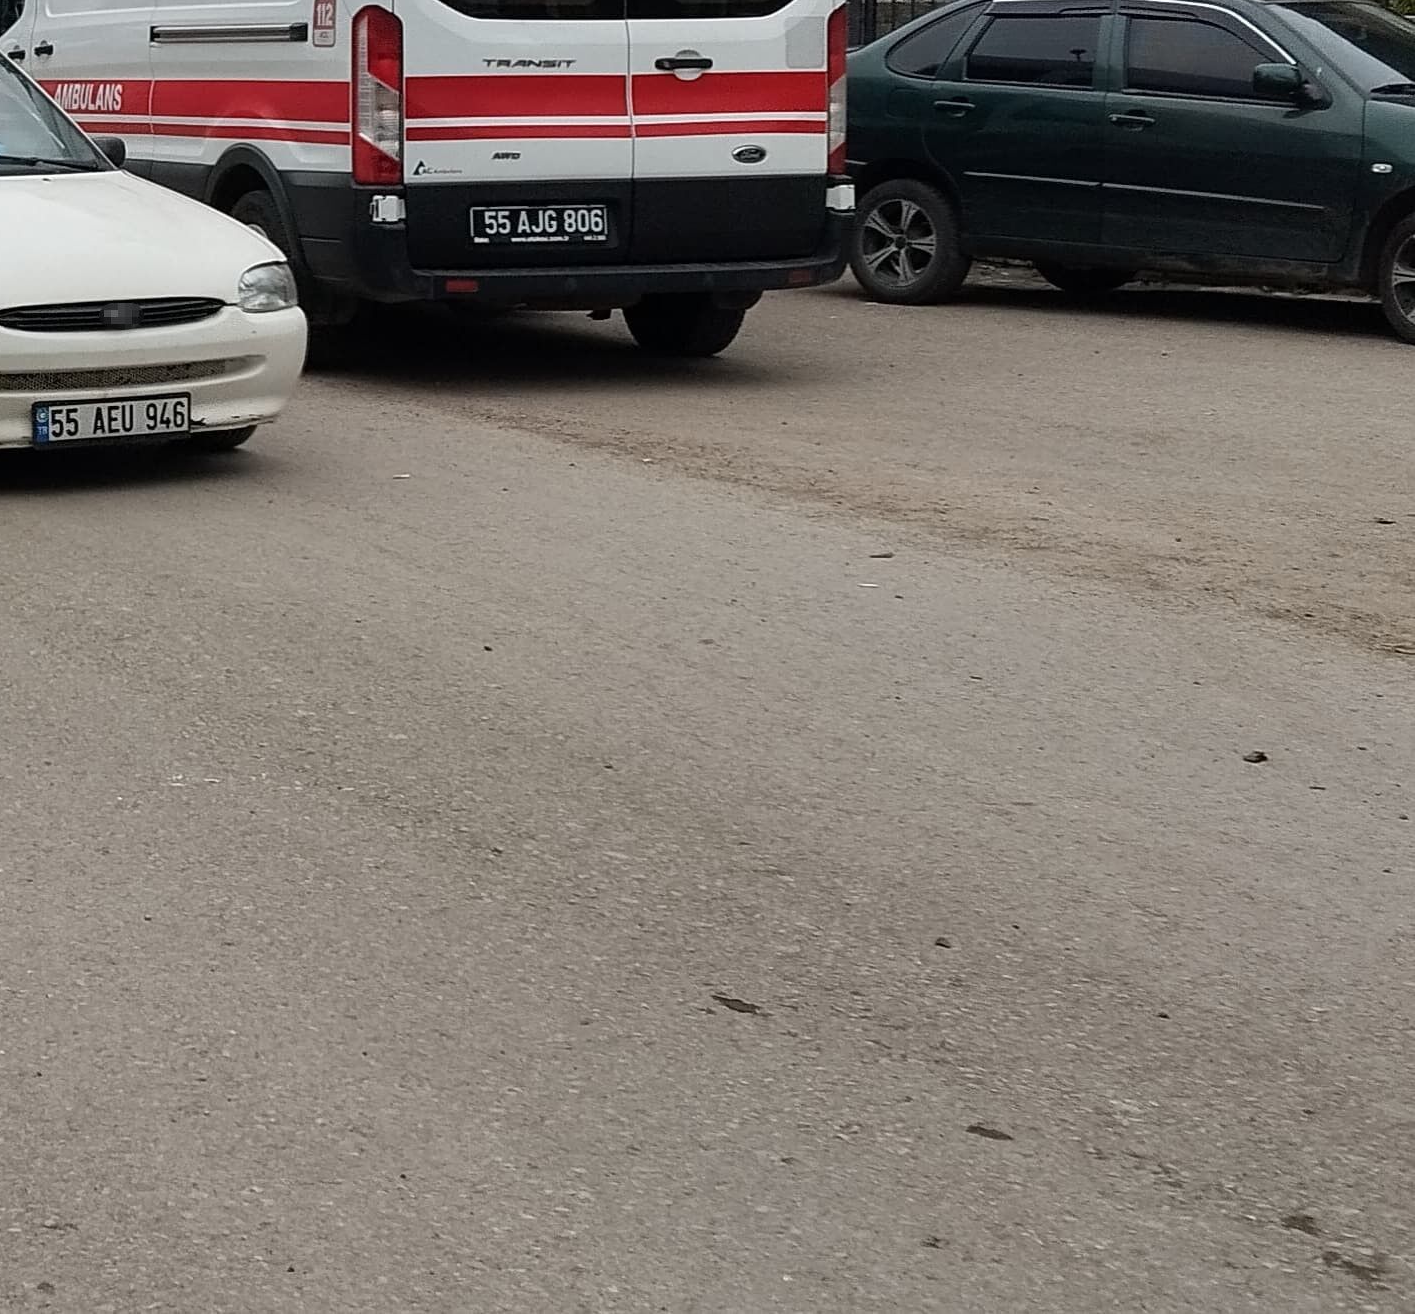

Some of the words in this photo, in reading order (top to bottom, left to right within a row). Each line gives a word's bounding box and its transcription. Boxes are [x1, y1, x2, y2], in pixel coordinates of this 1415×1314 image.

[316, 3, 334, 26] 112
[482, 58, 577, 68] TRANSIT
[54, 83, 124, 111] AMBULANS
[484, 210, 512, 235] 55
[516, 209, 558, 234] AJG
[563, 208, 604, 233] 806
[51, 407, 79, 438] 55
[93, 403, 134, 435] AEU
[146, 401, 185, 431] 946
